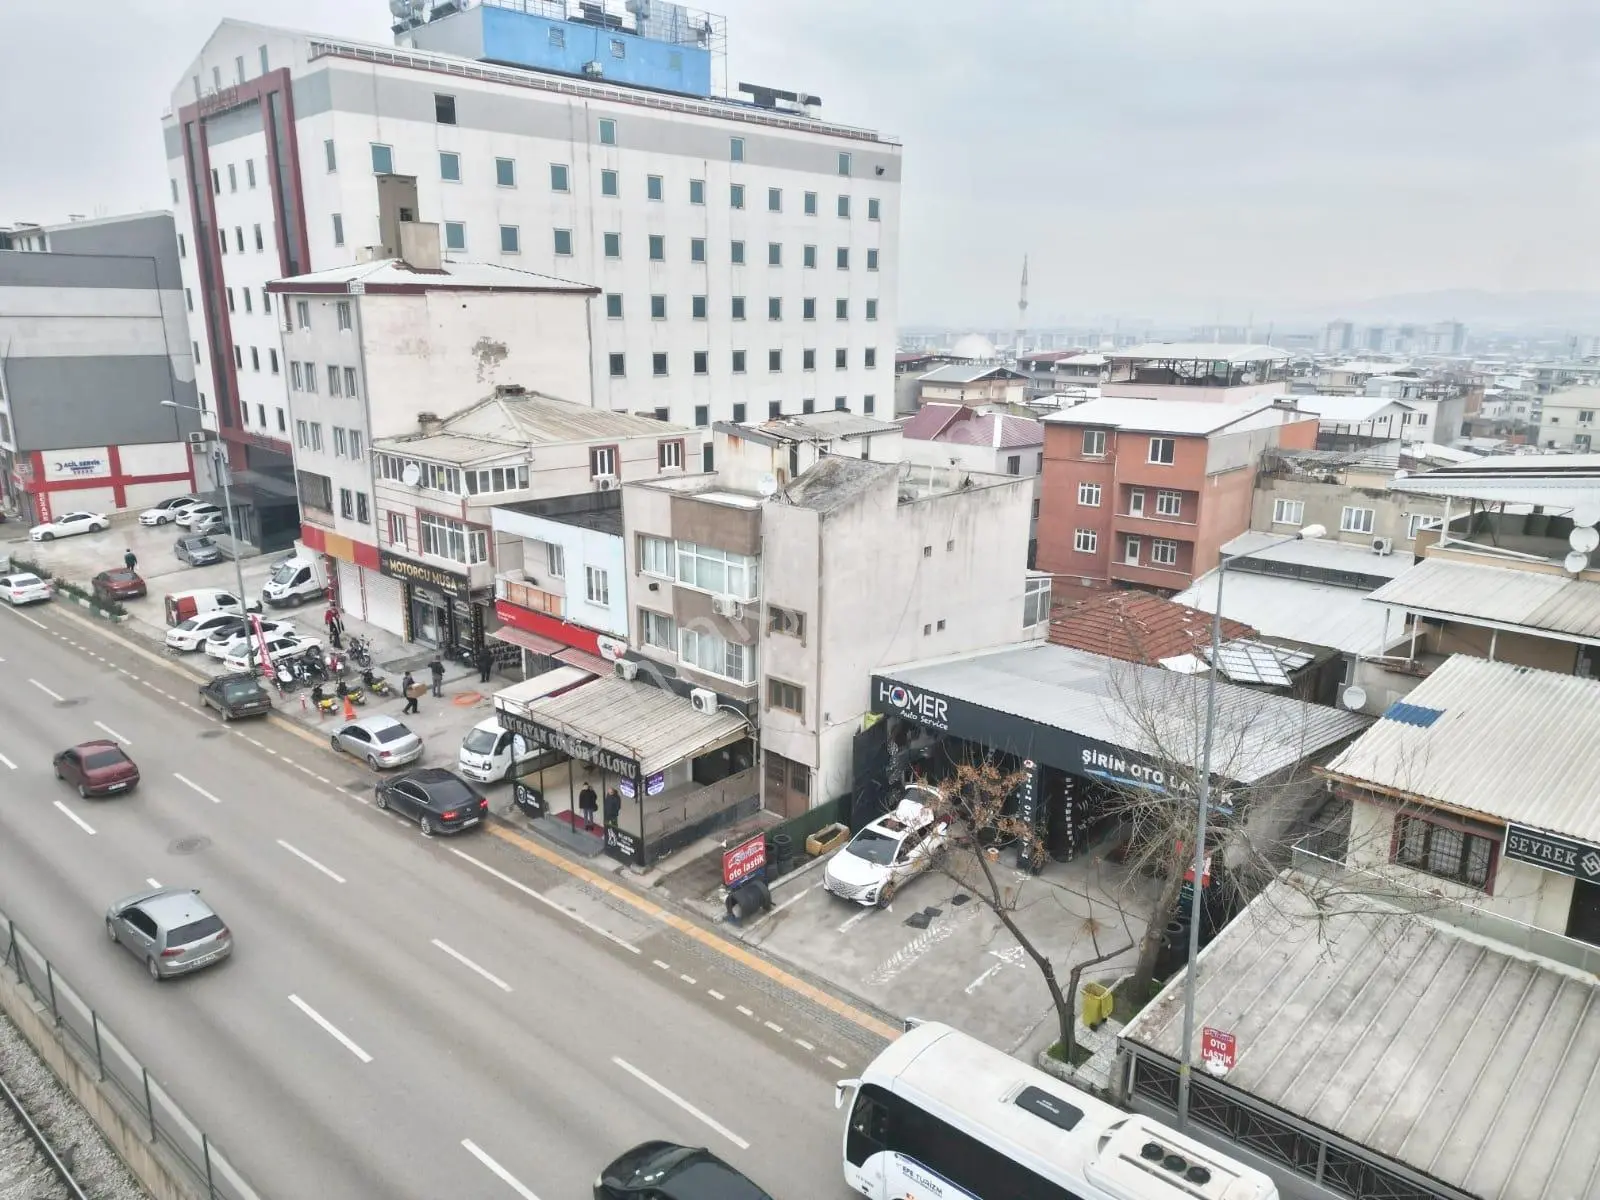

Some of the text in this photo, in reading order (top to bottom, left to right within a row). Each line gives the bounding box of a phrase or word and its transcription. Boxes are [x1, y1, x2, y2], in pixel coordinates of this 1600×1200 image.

[389, 558, 457, 591] MOTORCU MUSA
[879, 681, 948, 722] HOMER
[900, 709, 949, 731] Auto Service
[592, 750, 637, 779] SALONU
[1081, 749, 1125, 773] ŞİRİN
[1129, 763, 1164, 784] OTO
[1509, 835, 1578, 866] SEYREK
[728, 868, 742, 880] oto
[743, 854, 764, 874] lastik
[1210, 1039, 1226, 1051] OTO
